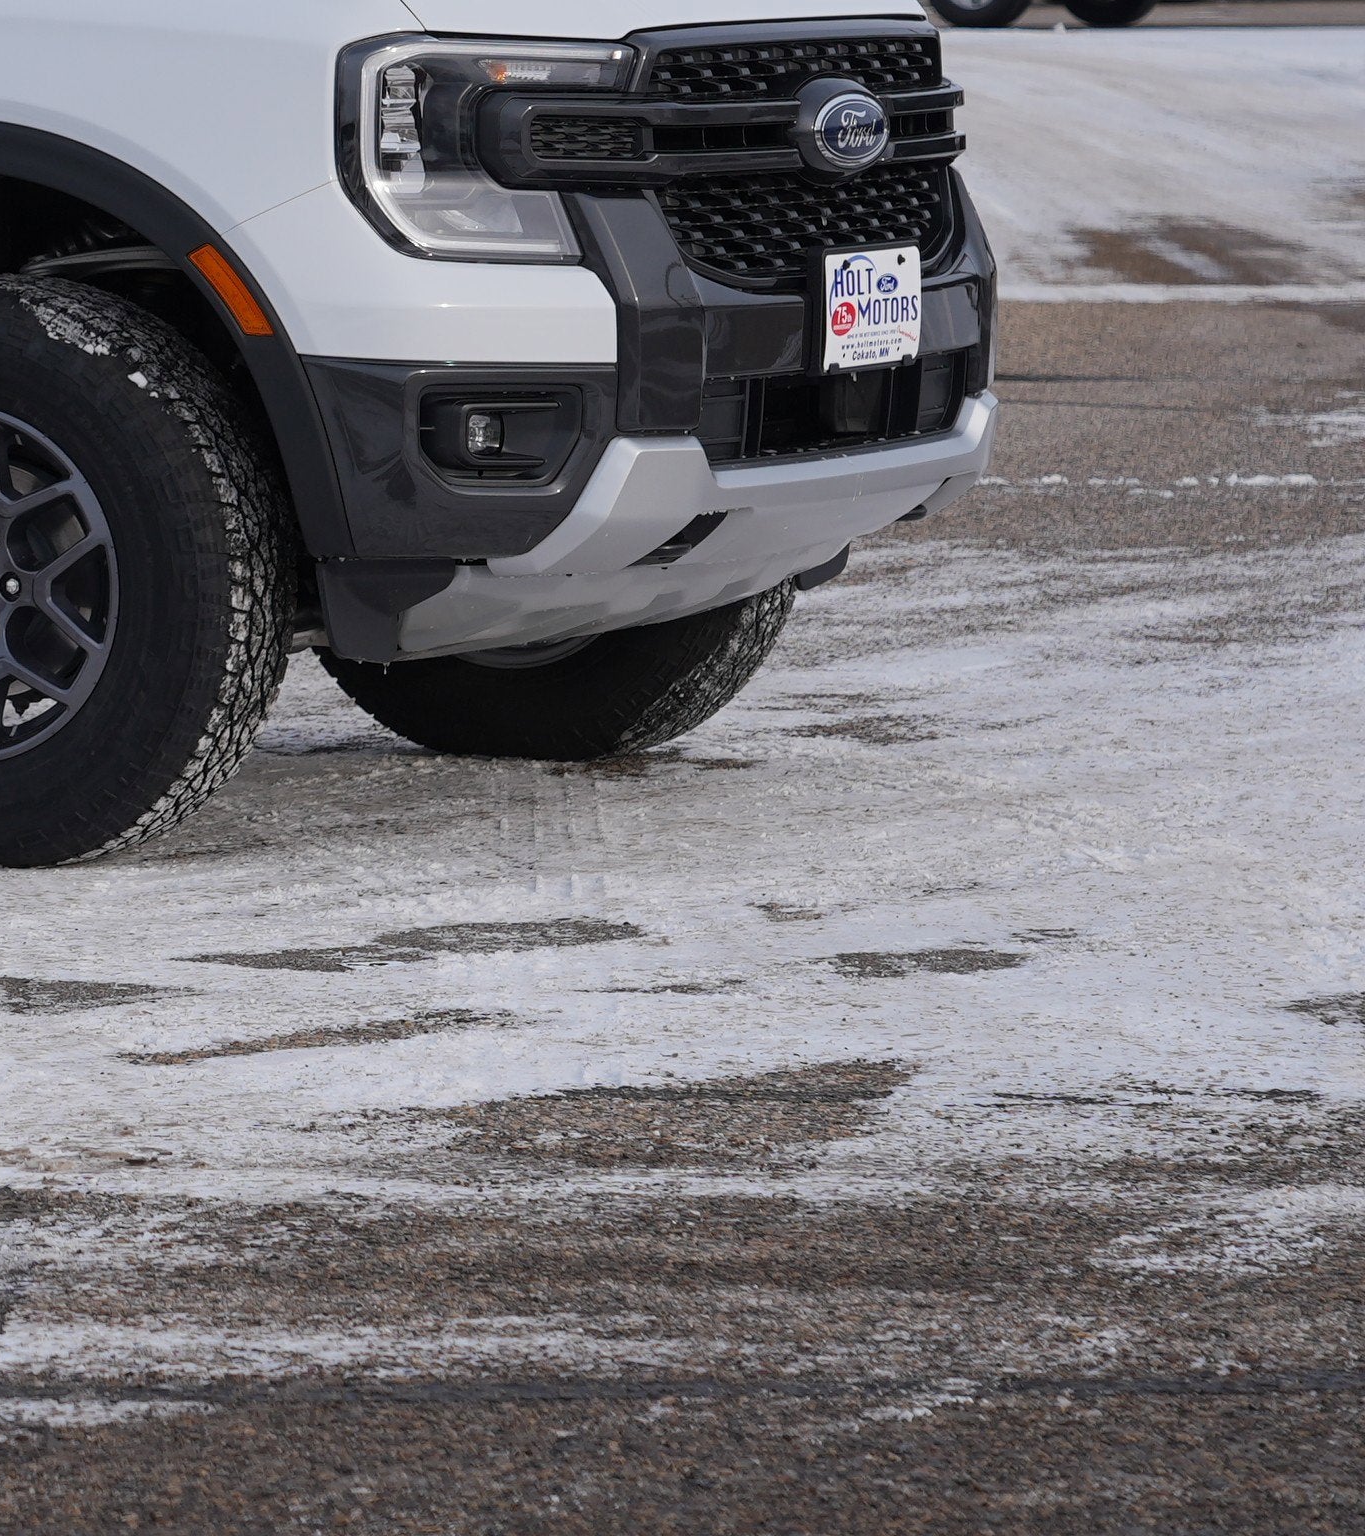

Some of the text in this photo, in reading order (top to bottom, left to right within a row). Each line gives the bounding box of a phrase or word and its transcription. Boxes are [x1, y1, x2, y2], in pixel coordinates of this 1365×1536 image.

[836, 108, 878, 149] Ford
[834, 267, 874, 298] HOLT
[857, 294, 919, 328] MOTORS
[852, 346, 890, 362] Cokato, MN
